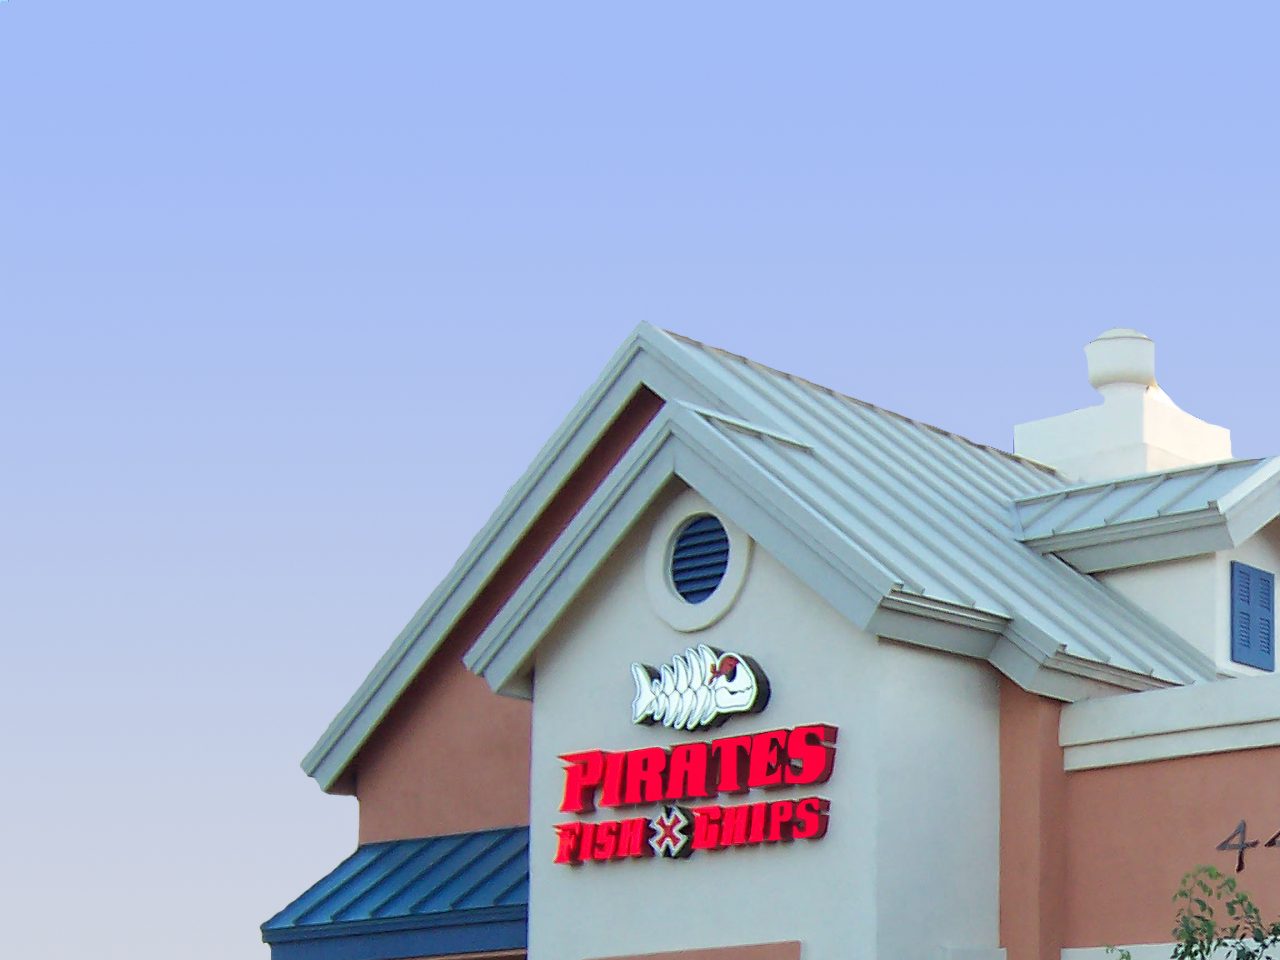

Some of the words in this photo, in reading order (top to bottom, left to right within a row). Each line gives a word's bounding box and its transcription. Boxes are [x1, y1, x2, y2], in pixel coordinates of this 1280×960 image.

[557, 723, 838, 813] PIRATES
[554, 818, 652, 865] FISH
[691, 796, 830, 850] CHIPS
